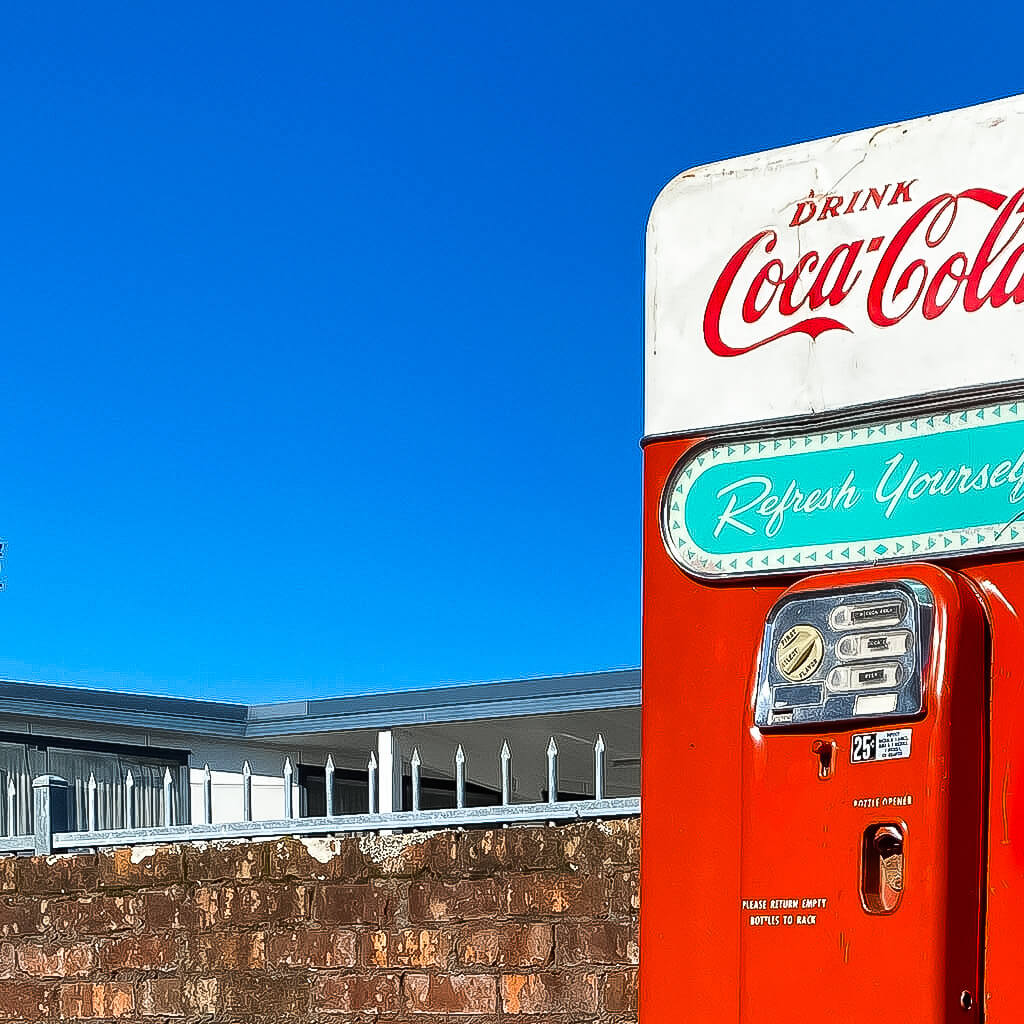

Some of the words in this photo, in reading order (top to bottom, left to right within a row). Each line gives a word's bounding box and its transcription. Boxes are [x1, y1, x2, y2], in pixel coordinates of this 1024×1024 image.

[789, 179, 919, 227] DRINK
[713, 470, 860, 538] Refresh
[742, 900, 767, 910] PLEASE
[770, 899, 799, 909] RETURN
[802, 898, 827, 909] EMPTY
[750, 915, 780, 926] BOTTLES
[783, 915, 793, 925] TO
[796, 915, 817, 925] RACK
